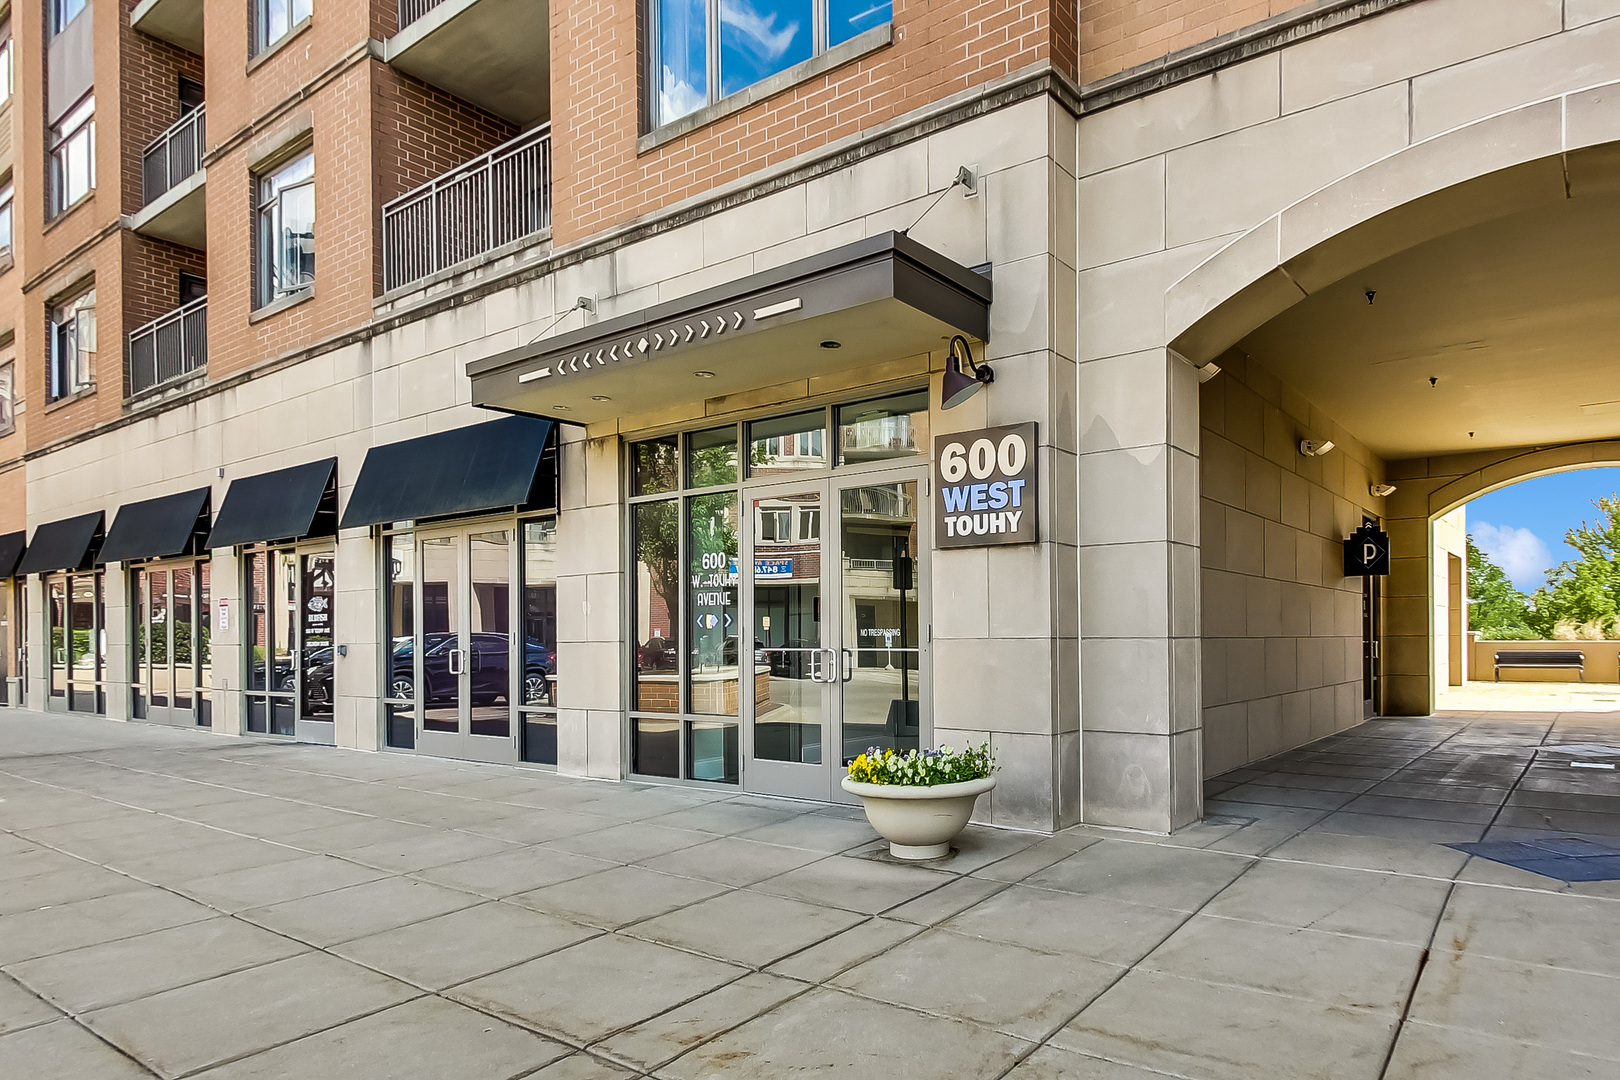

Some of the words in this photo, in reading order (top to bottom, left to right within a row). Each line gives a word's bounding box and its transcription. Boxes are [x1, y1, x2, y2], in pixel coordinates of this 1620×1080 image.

[940, 433, 1027, 483] 600
[941, 479, 1025, 513] WEST
[944, 510, 1023, 537] TOUHY
[702, 552, 726, 570] 600
[1363, 543, 1377, 565] P
[697, 591, 731, 607] AVENUE
[860, 628, 868, 637] NO
[868, 628, 901, 637] TRESPASSING
